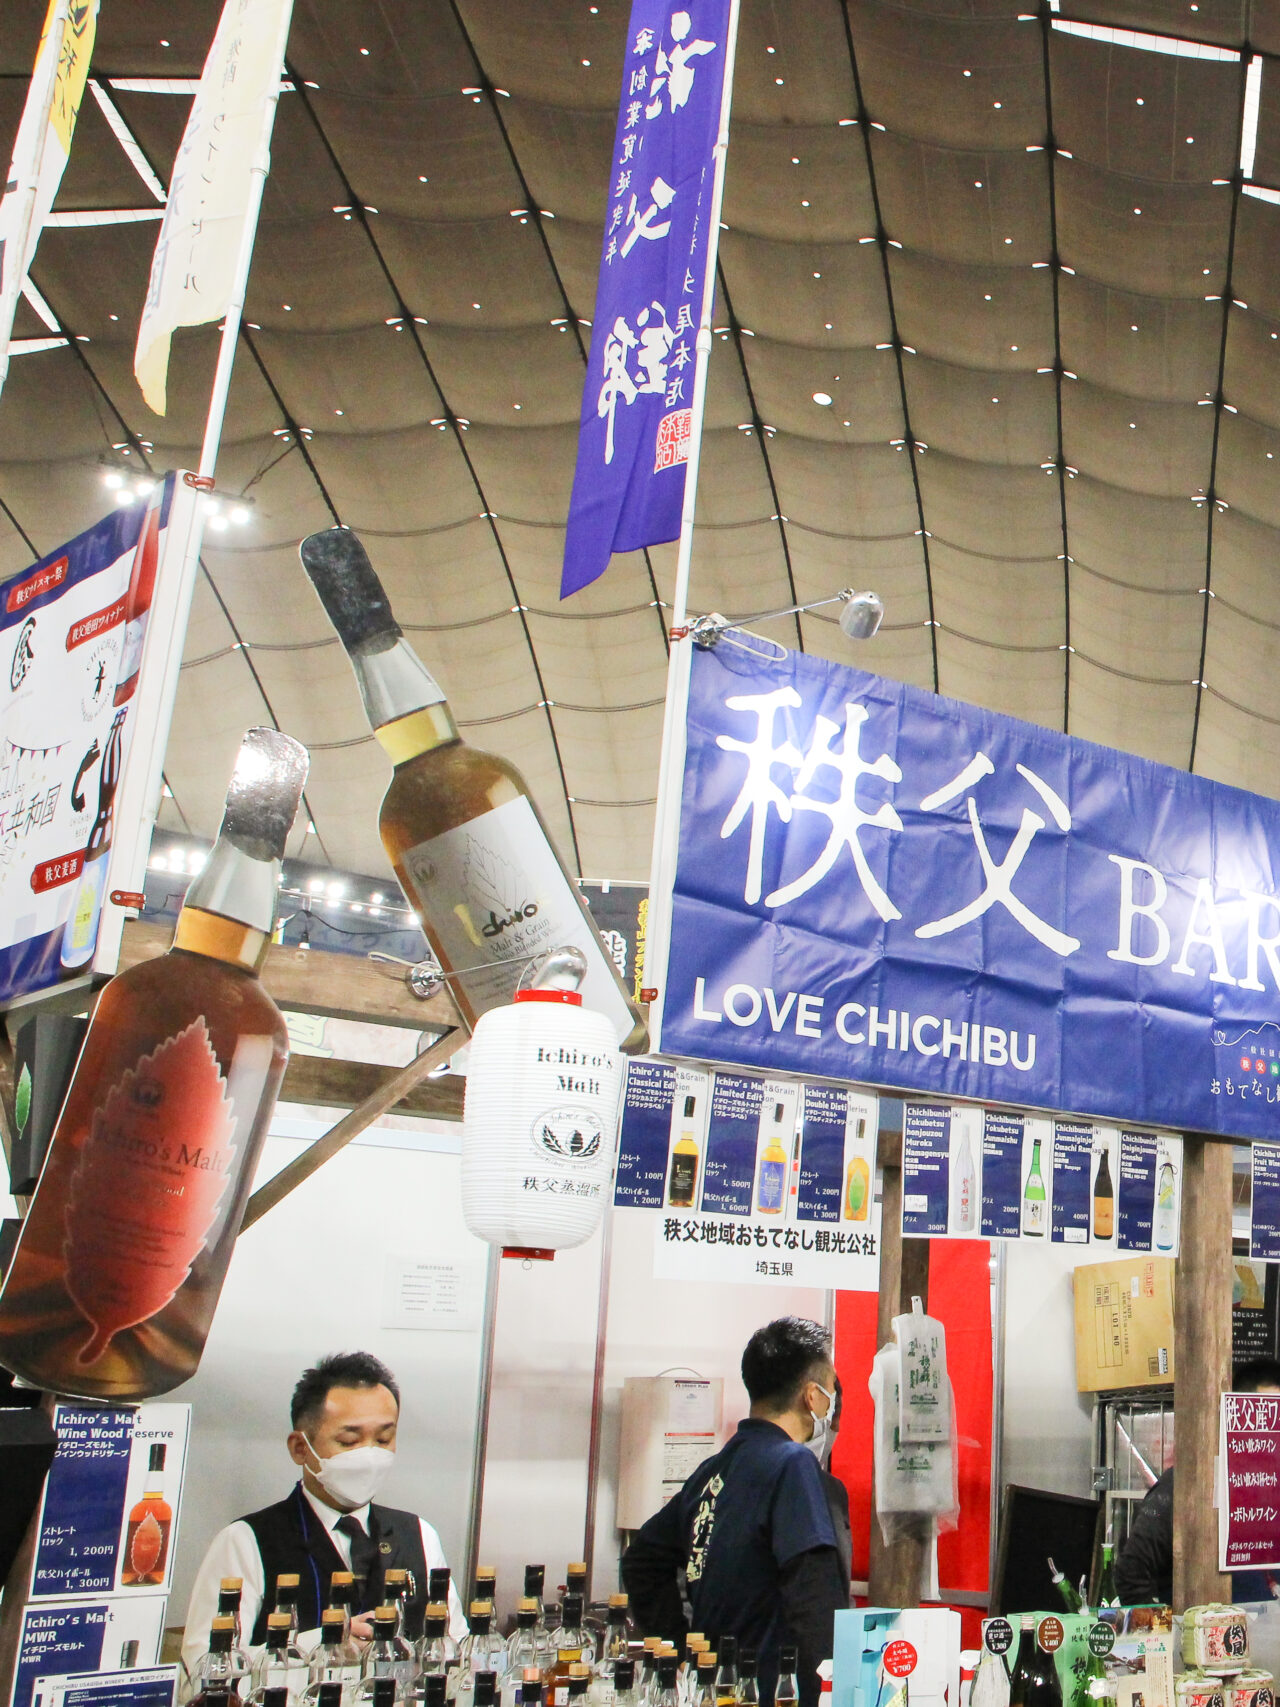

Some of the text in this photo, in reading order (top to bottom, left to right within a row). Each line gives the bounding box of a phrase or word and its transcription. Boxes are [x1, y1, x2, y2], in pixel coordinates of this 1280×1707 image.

[716, 685, 1081, 957] 秩父
[44, 857, 78, 882] 秩父麦酒
[491, 938, 512, 955] Malt
[693, 976, 1037, 1072] LOVE CHICHIBU
[537, 1047, 613, 1070] Ichiro's
[629, 1066, 661, 1078] Ichiro's
[556, 1075, 601, 1095] Malt
[628, 1077, 690, 1091] Classical Edition
[716, 1077, 748, 1089] Ichiro's
[715, 1087, 748, 1099] Limited
[805, 1088, 852, 1102] Ichiro's Malt
[805, 1099, 829, 1110] Double
[907, 1118, 945, 1128] Tokubetsu
[906, 1128, 943, 1139] honjouzou
[985, 1124, 1019, 1135] Tokubetsu
[906, 1138, 933, 1147] Muroka
[984, 1134, 1018, 1145] Junmaishu
[1055, 1144, 1077, 1152] Omachi
[177, 1142, 224, 1172] Malt
[620, 1153, 641, 1161] ストレート
[706, 1161, 728, 1170] ストレート
[616, 1186, 650, 1196] 秩父ハイボール
[704, 1193, 737, 1203] 秩父ハイボール
[663, 1217, 877, 1256] 秩父地域おもてなし観光公社
[756, 1261, 793, 1276] 埼玉県
[58, 1412, 143, 1426] Ichiro's Malt
[57, 1428, 174, 1439] Wine Wood Reserve
[54, 1449, 129, 1458] ワインウッドリザーブ
[43, 1526, 76, 1536] ストレート
[41, 1537, 63, 1546] ロック
[69, 1546, 114, 1557] 1,200円
[1231, 1552, 1251, 1563] 送料無料
[37, 1568, 91, 1579] 秩父ハイボール
[65, 1578, 110, 1589] 1,300円
[27, 1611, 114, 1629] Ichiro's Malt
[25, 1631, 57, 1644] MWR
[23, 1642, 85, 1655] イチローズモルト
[21, 1654, 41, 1664] MWR
[892, 1664, 911, 1674] ¥700
[104, 1678, 125, 1686] WINERY
